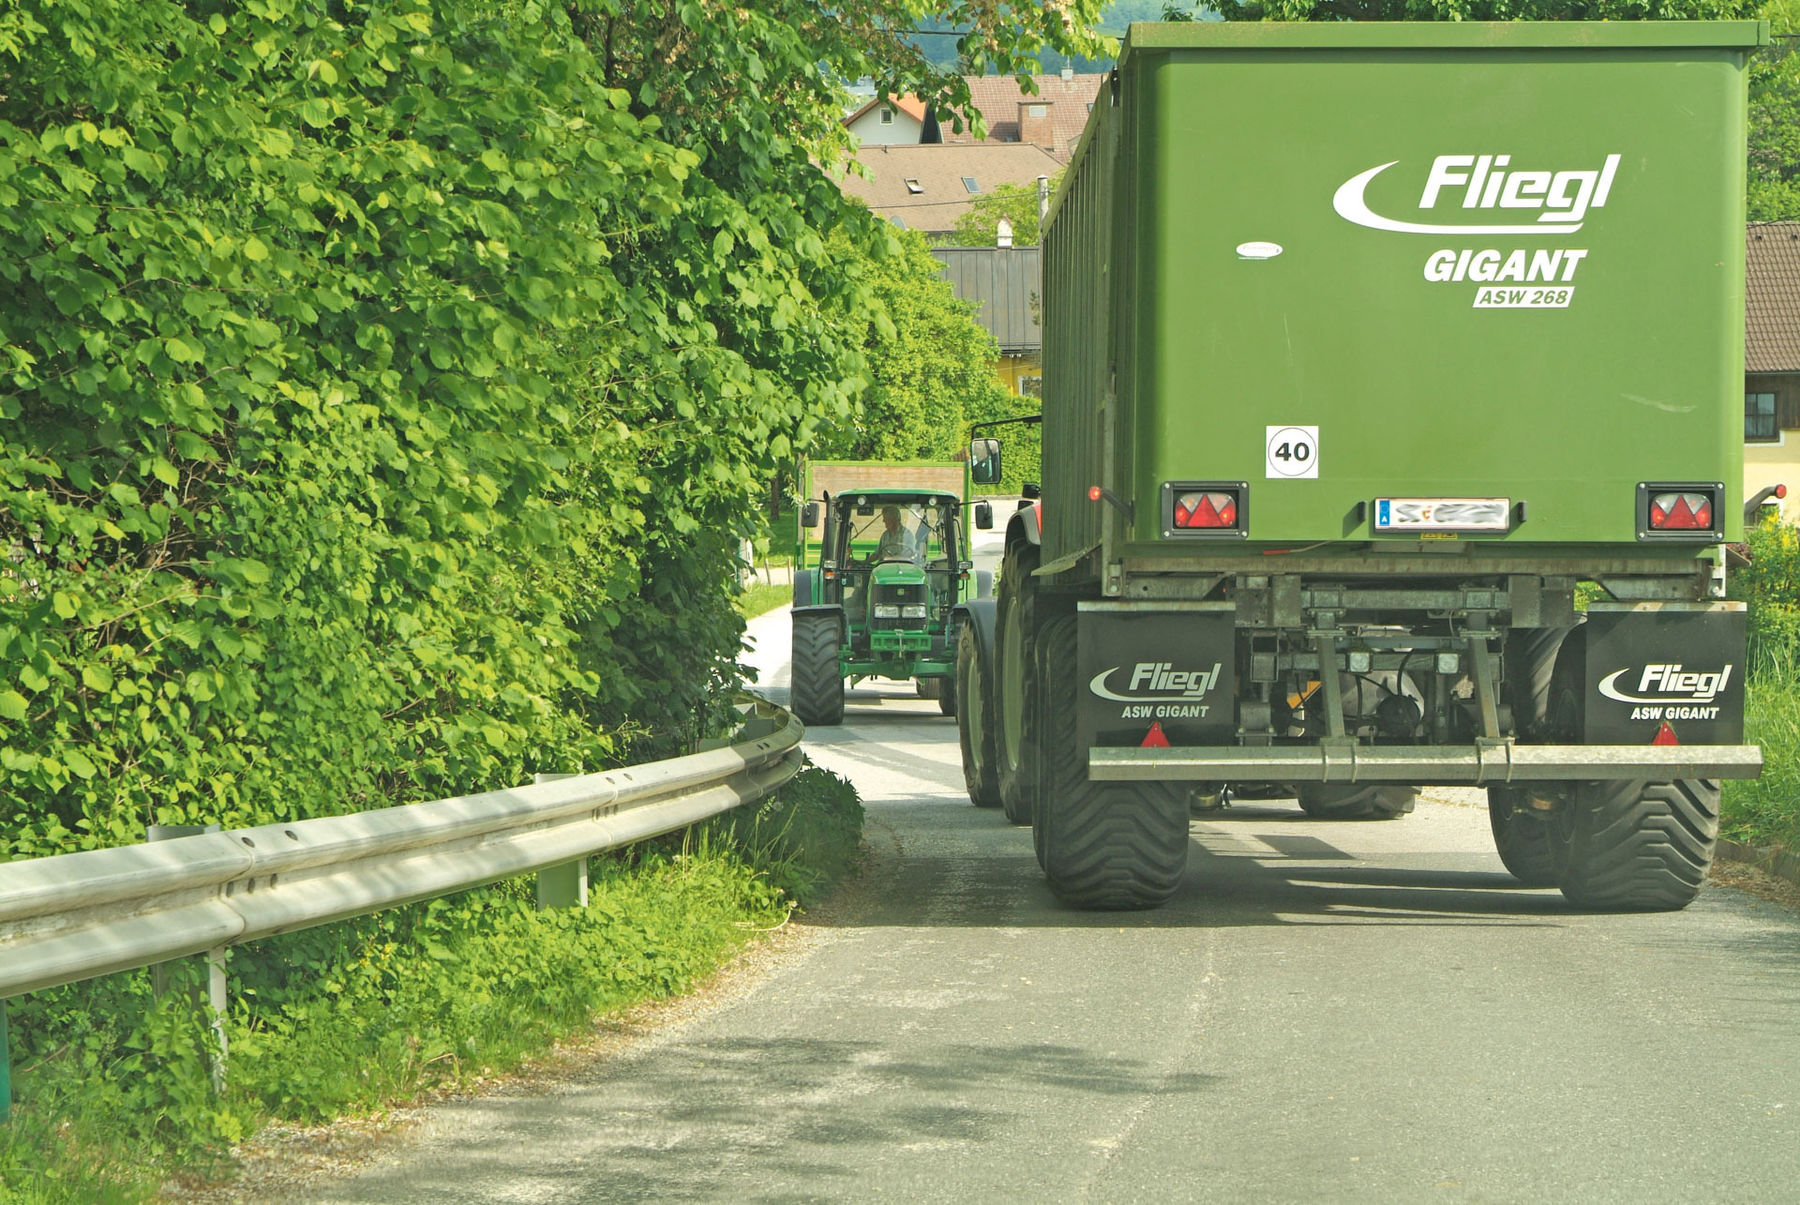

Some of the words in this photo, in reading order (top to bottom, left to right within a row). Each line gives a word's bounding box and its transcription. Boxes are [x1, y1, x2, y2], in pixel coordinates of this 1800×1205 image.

[1418, 154, 1622, 222] Fliegl
[1423, 249, 1589, 282] GIGANT
[1479, 290, 1527, 305] ASW
[1530, 290, 1568, 305] 268
[1275, 442, 1310, 462] 40
[1128, 662, 1222, 696] Fliegl
[1638, 664, 1733, 698] Fliegl
[1121, 705, 1153, 718] ASW
[1155, 705, 1210, 718] GIGANT
[1630, 707, 1663, 720] ASW
[1664, 707, 1720, 720] GIGANT
